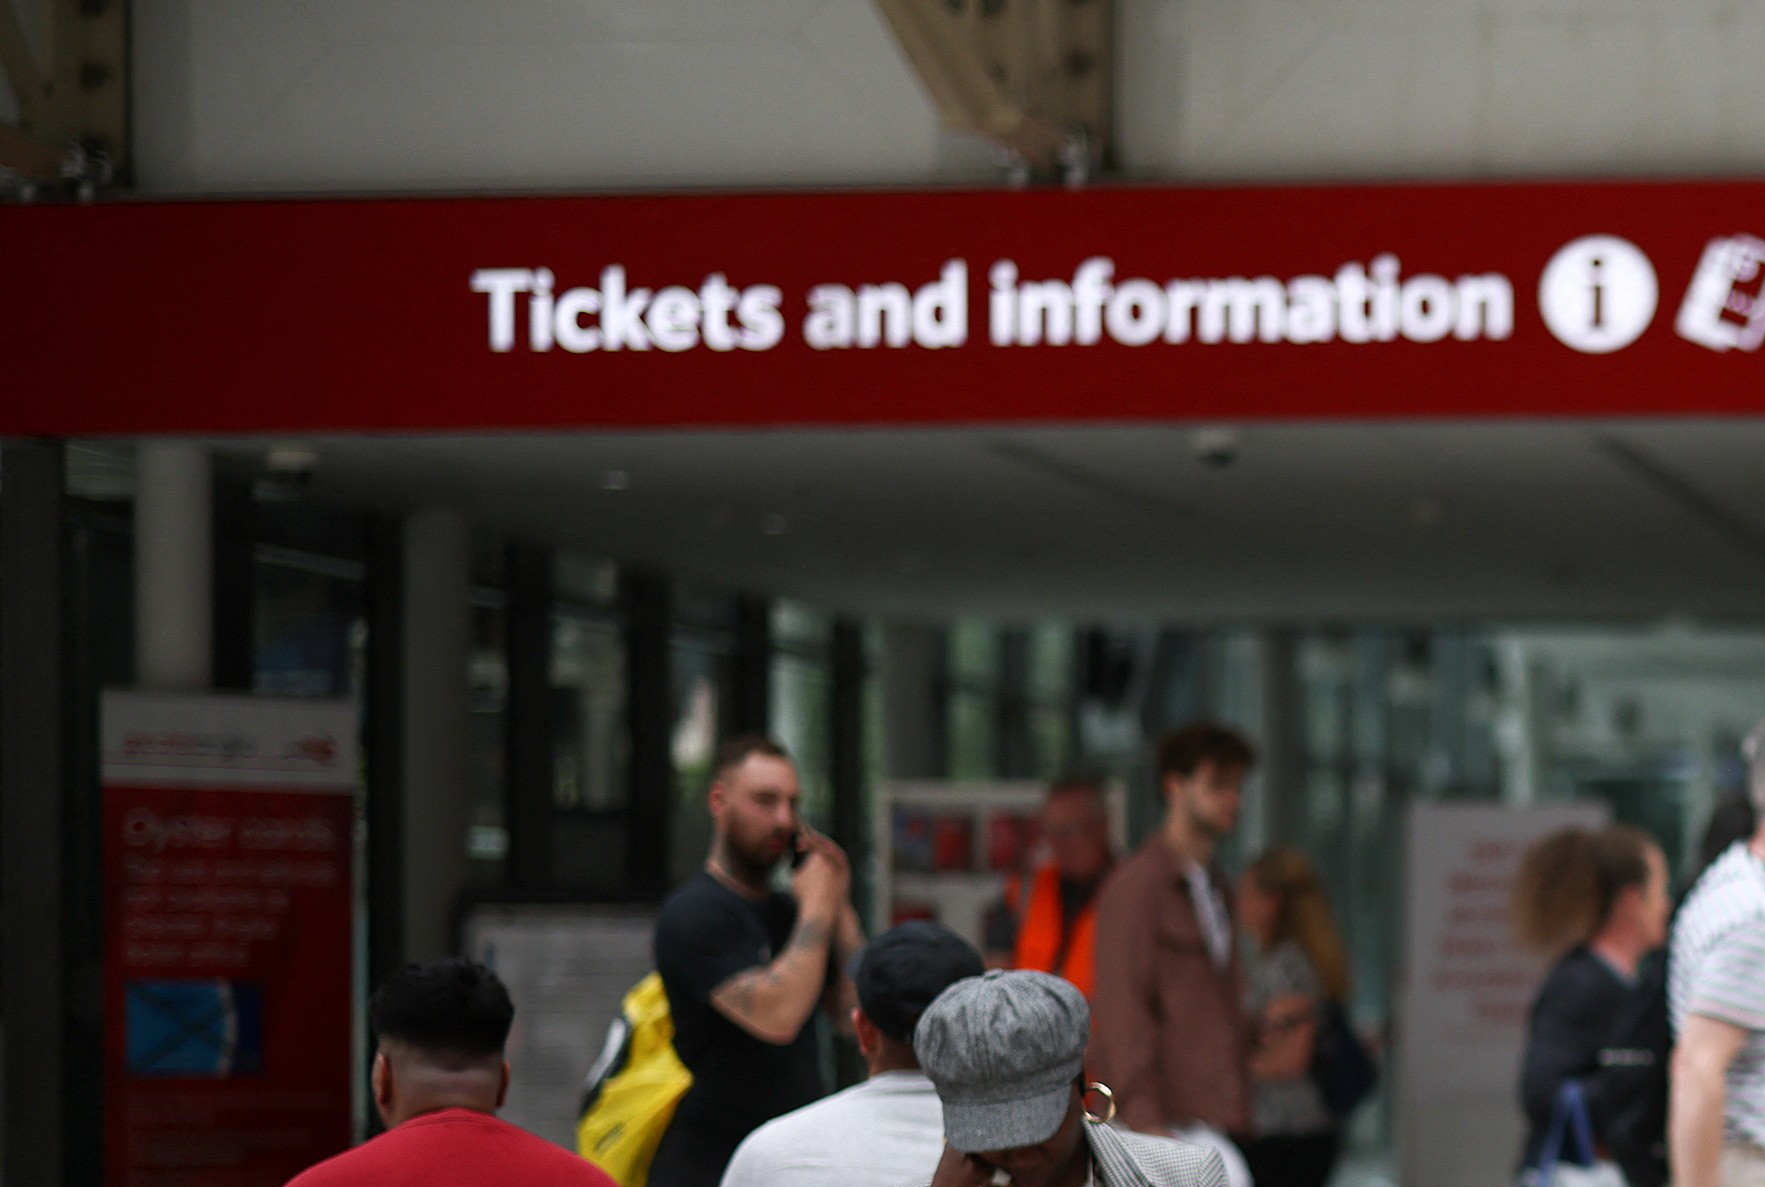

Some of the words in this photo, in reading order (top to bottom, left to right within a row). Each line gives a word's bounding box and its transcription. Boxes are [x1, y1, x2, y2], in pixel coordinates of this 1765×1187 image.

[471, 263, 786, 352] Tickets
[803, 256, 968, 349] and
[988, 255, 1514, 347] information
